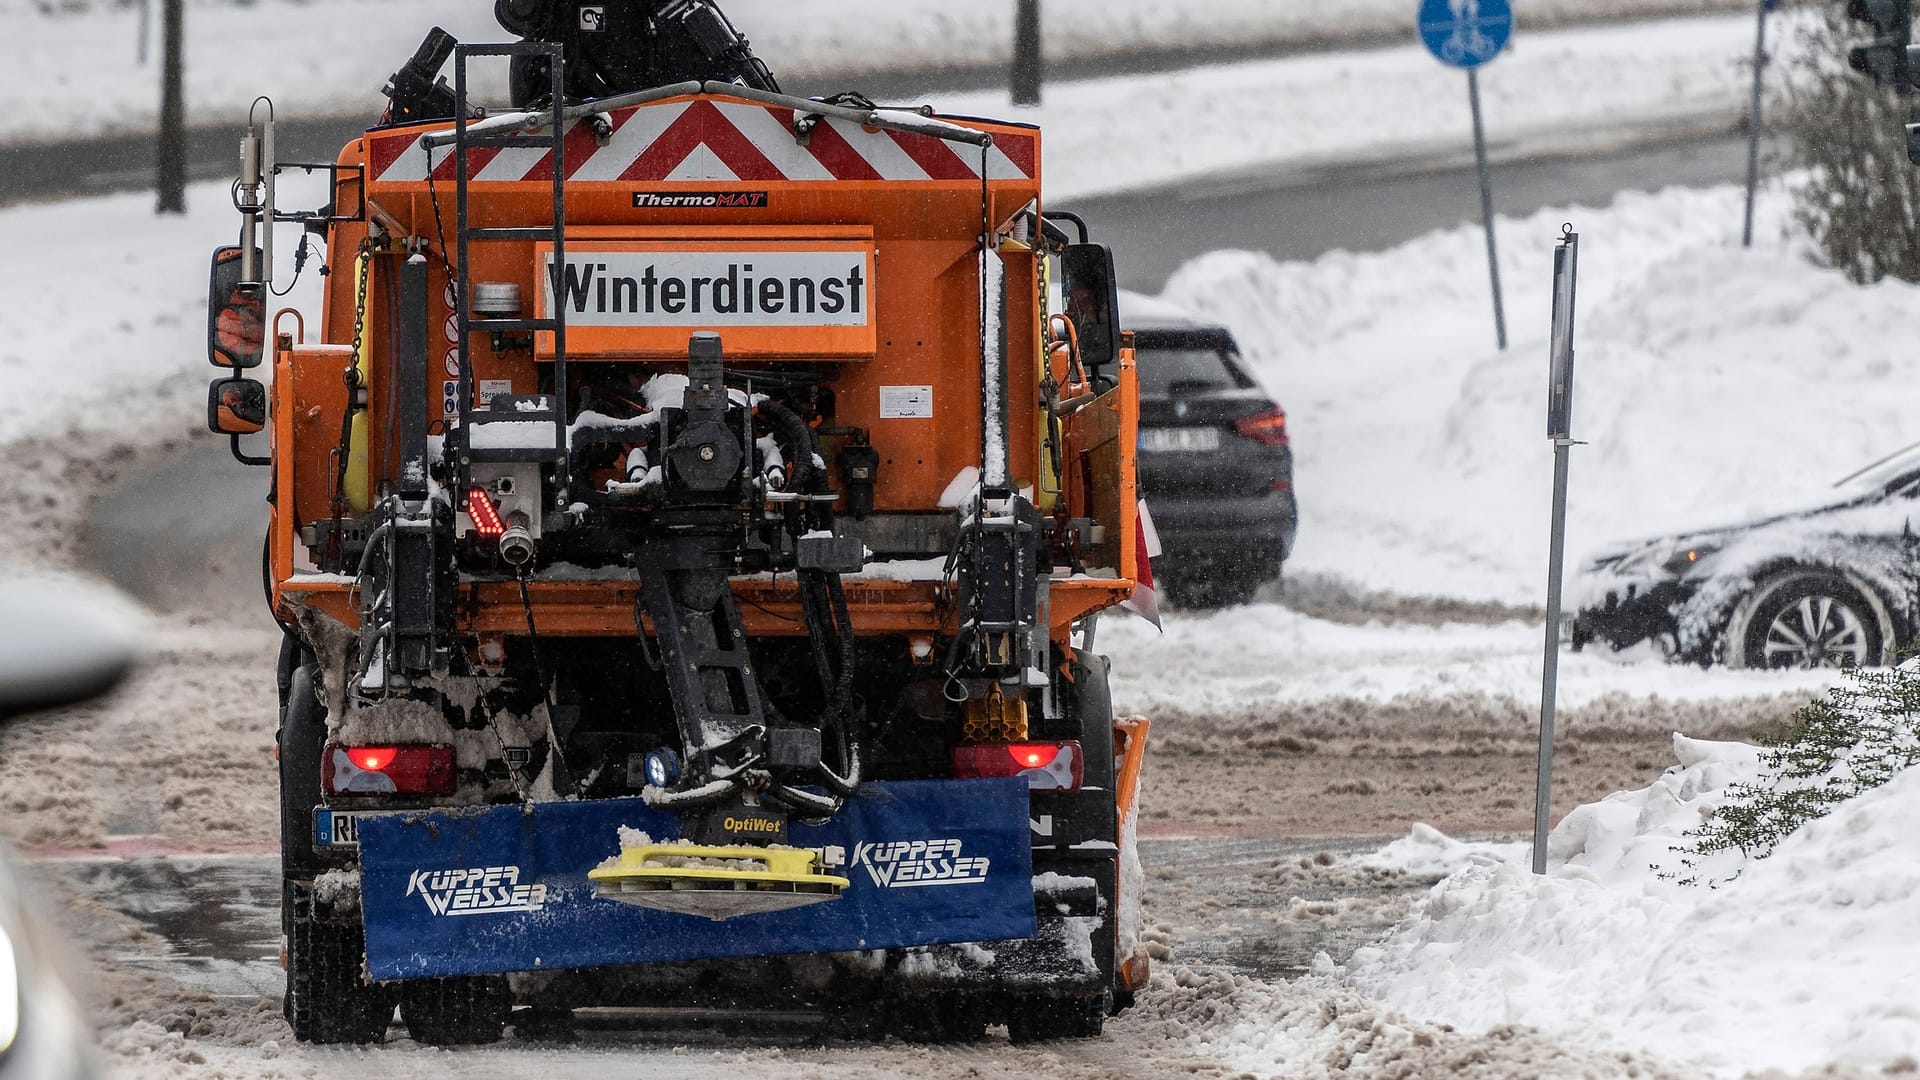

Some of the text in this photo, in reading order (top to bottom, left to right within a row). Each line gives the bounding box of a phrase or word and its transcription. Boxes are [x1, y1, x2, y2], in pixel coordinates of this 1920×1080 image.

[636, 193, 764, 207] ThermoMAT
[547, 263, 864, 314] Winterdienst
[723, 817, 781, 833] OptiWet
[320, 831, 328, 840] D
